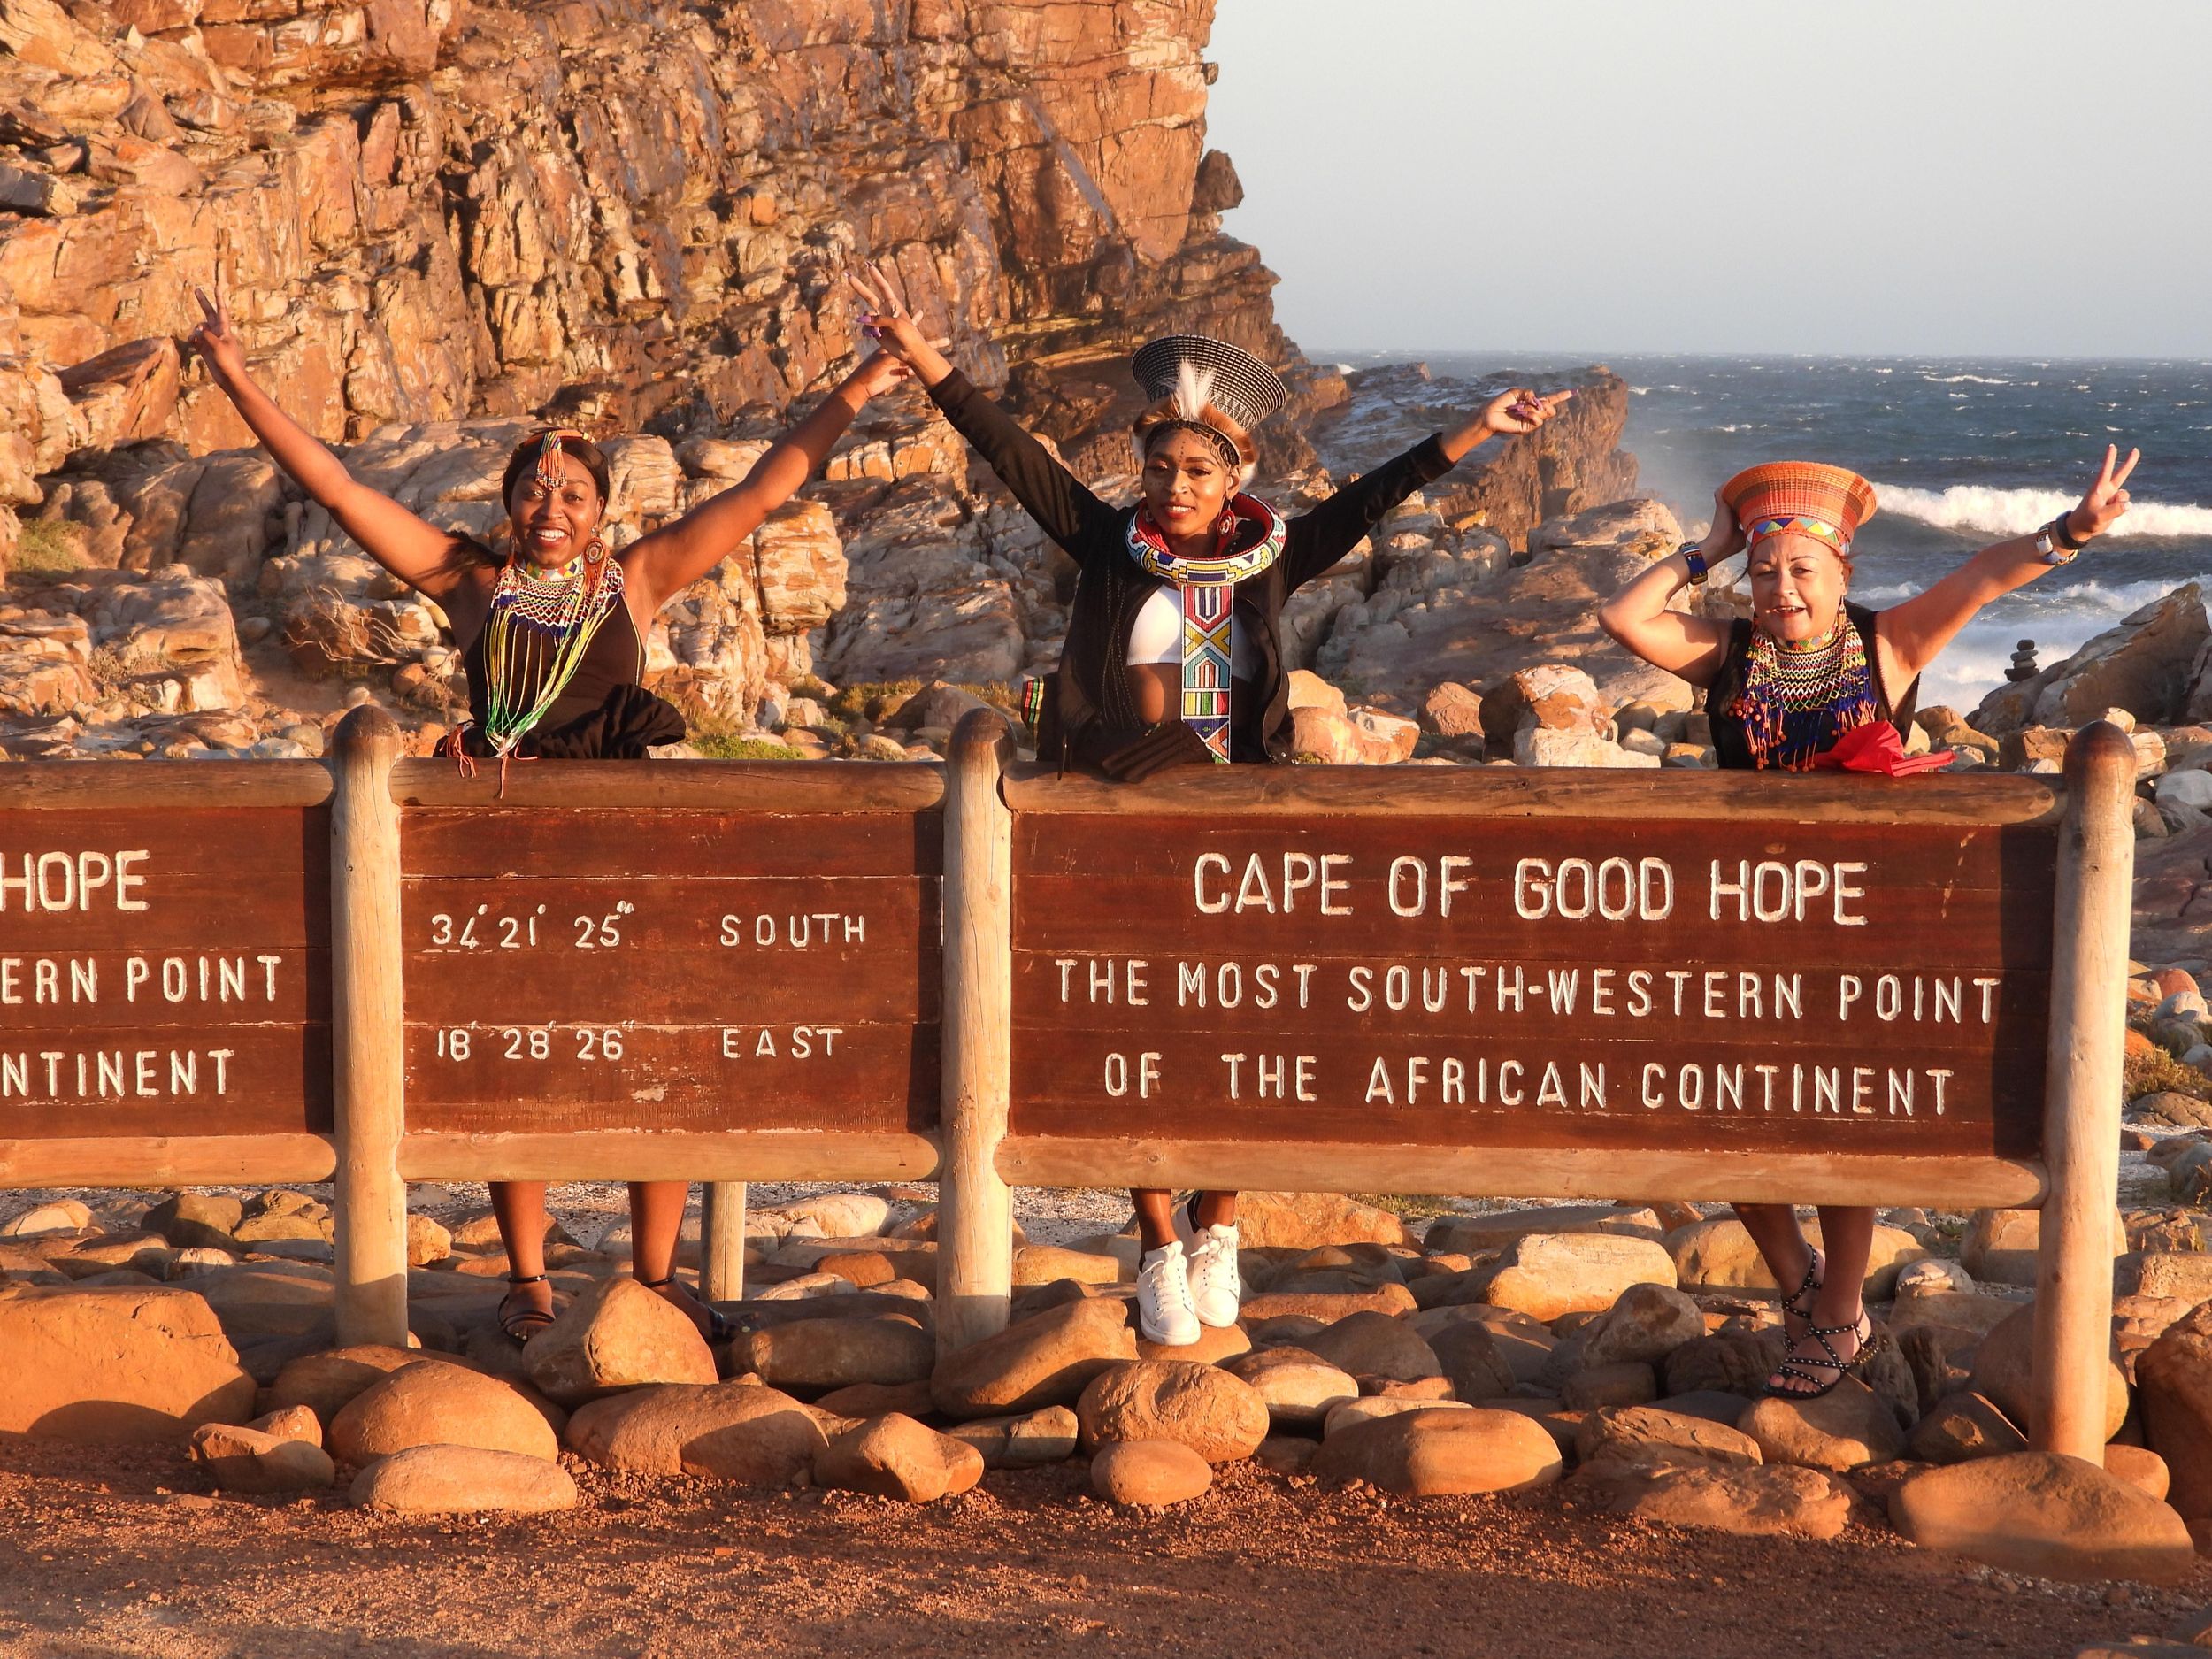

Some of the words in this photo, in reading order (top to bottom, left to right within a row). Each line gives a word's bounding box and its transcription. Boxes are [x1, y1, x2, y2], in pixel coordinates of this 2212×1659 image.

[0, 850, 150, 912] HOPE
[1194, 852, 1354, 916] CAPE
[1388, 856, 1473, 918] OF
[1514, 857, 1674, 921] GOOD
[1710, 859, 1869, 926] HOPE
[719, 912, 865, 948] SOUTH
[1, 958, 98, 1004] ERN
[127, 956, 282, 1002] POINT
[1056, 959, 1149, 1006] THE
[1178, 961, 1317, 1009] MOST
[1347, 964, 1803, 1019] SOUTH-WESTERN
[1839, 974, 2001, 1024] POINT
[722, 1028, 843, 1059] EAST
[2, 1049, 234, 1097] NTINENT
[1104, 1052, 1163, 1098] OF
[1221, 1053, 1318, 1102] THE
[1365, 1056, 1606, 1109] AFRICAN
[1642, 1063, 1954, 1116] CONTINENT
